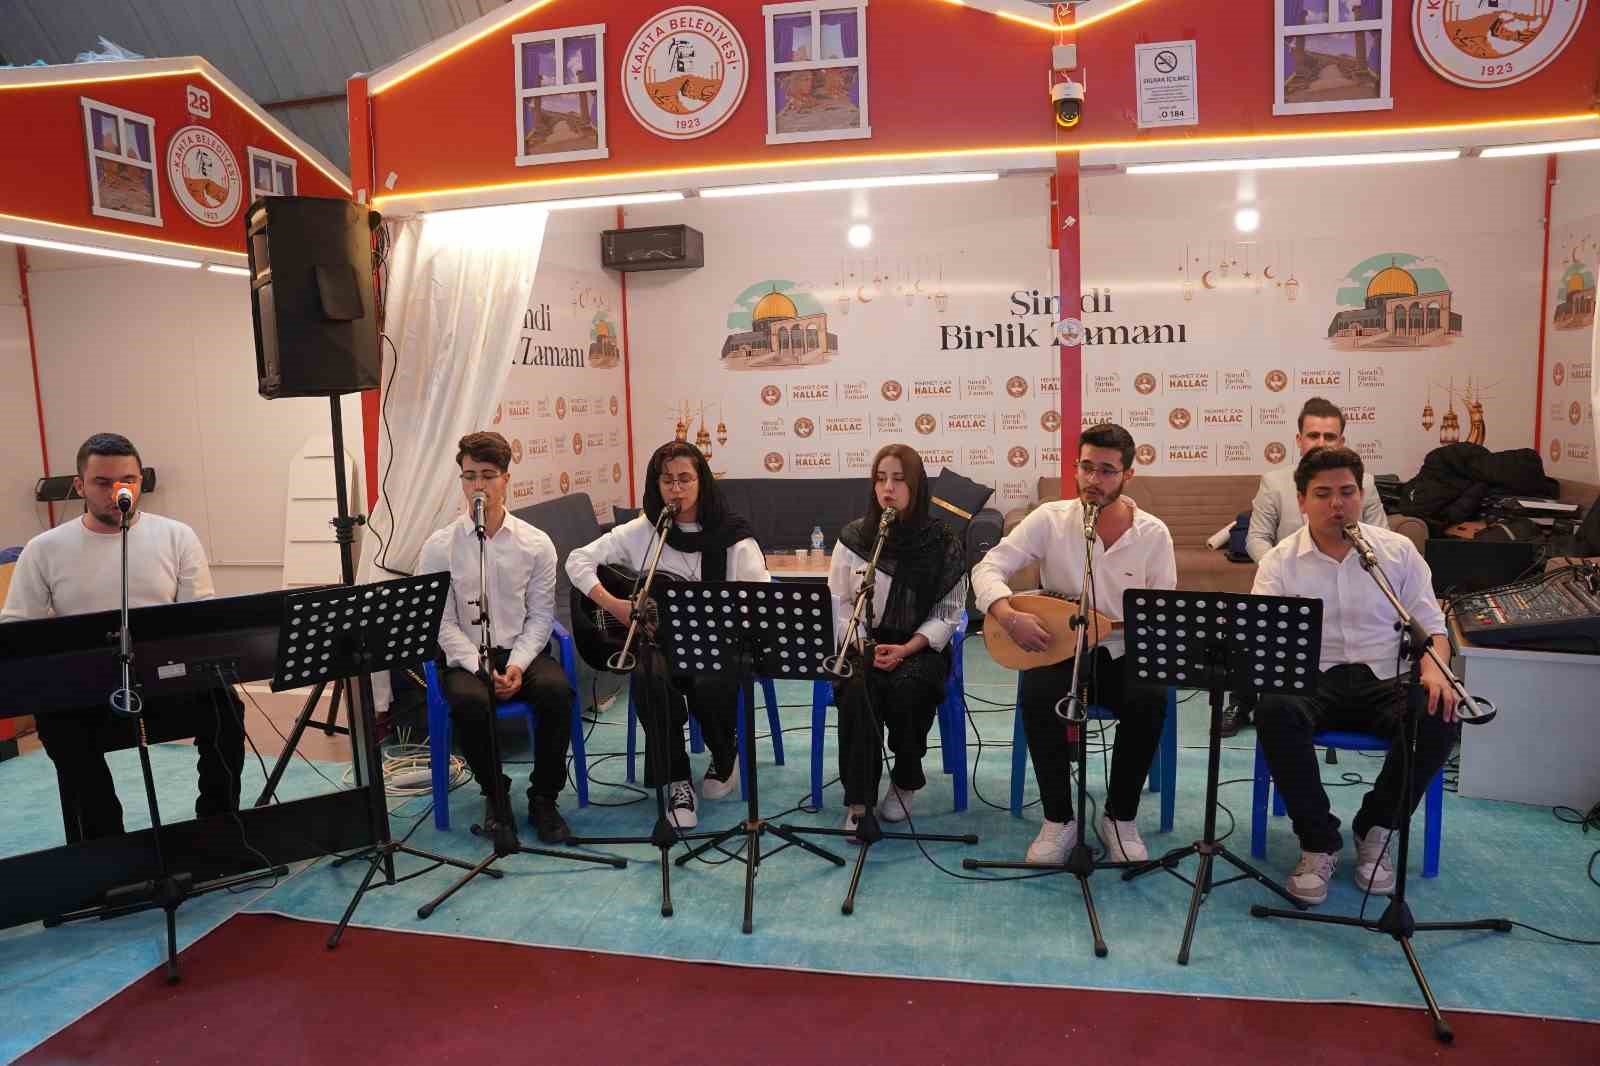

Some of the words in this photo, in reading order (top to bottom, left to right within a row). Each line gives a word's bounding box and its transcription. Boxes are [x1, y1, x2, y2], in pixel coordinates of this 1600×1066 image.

[1480, 62, 1513, 76] 1923
[189, 91, 209, 113] 28
[675, 117, 701, 129] 1923
[1010, 287, 1115, 318] Şidi
[939, 322, 1040, 351] Birlik
[520, 336, 585, 368] Zamanı
[1081, 416, 1113, 425] ALLAC
[1343, 412, 1376, 421] ALLAC
[920, 455, 953, 463] ALLAC
